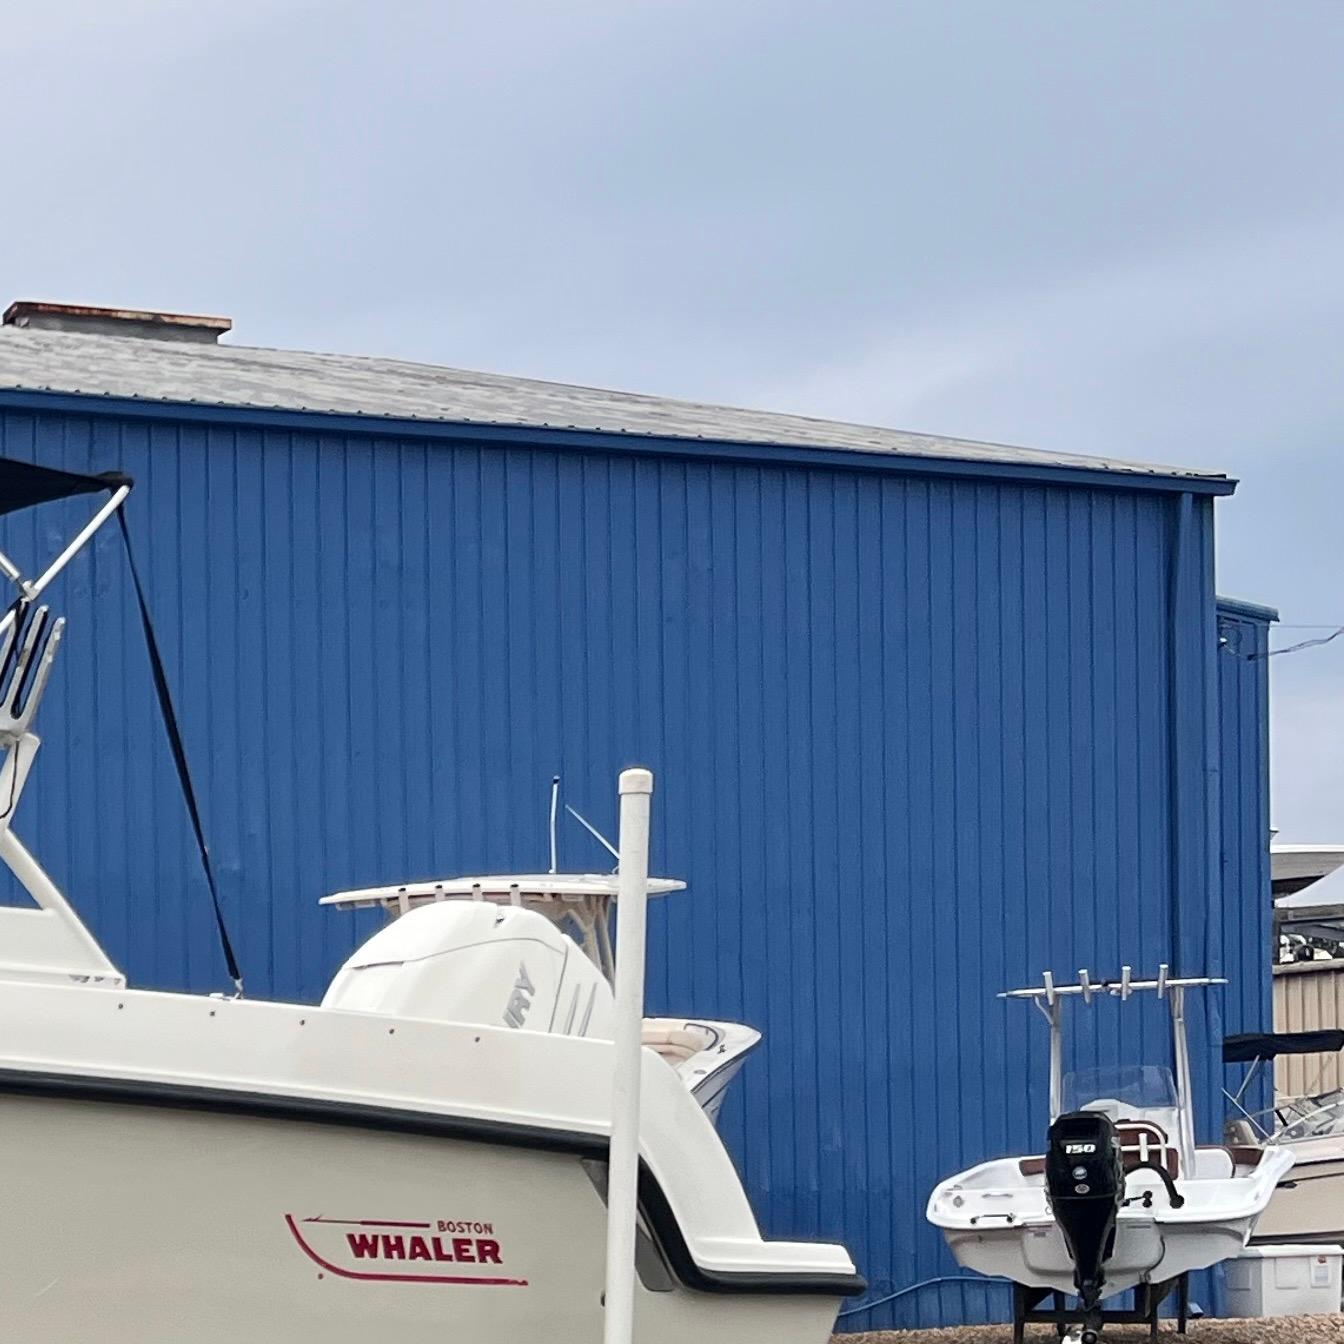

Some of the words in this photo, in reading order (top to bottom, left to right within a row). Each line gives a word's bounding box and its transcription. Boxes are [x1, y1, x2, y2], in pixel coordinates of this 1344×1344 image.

[1066, 1144, 1096, 1154] 150
[438, 1220, 494, 1235] BOSTON
[346, 1233, 504, 1265] WHALER
